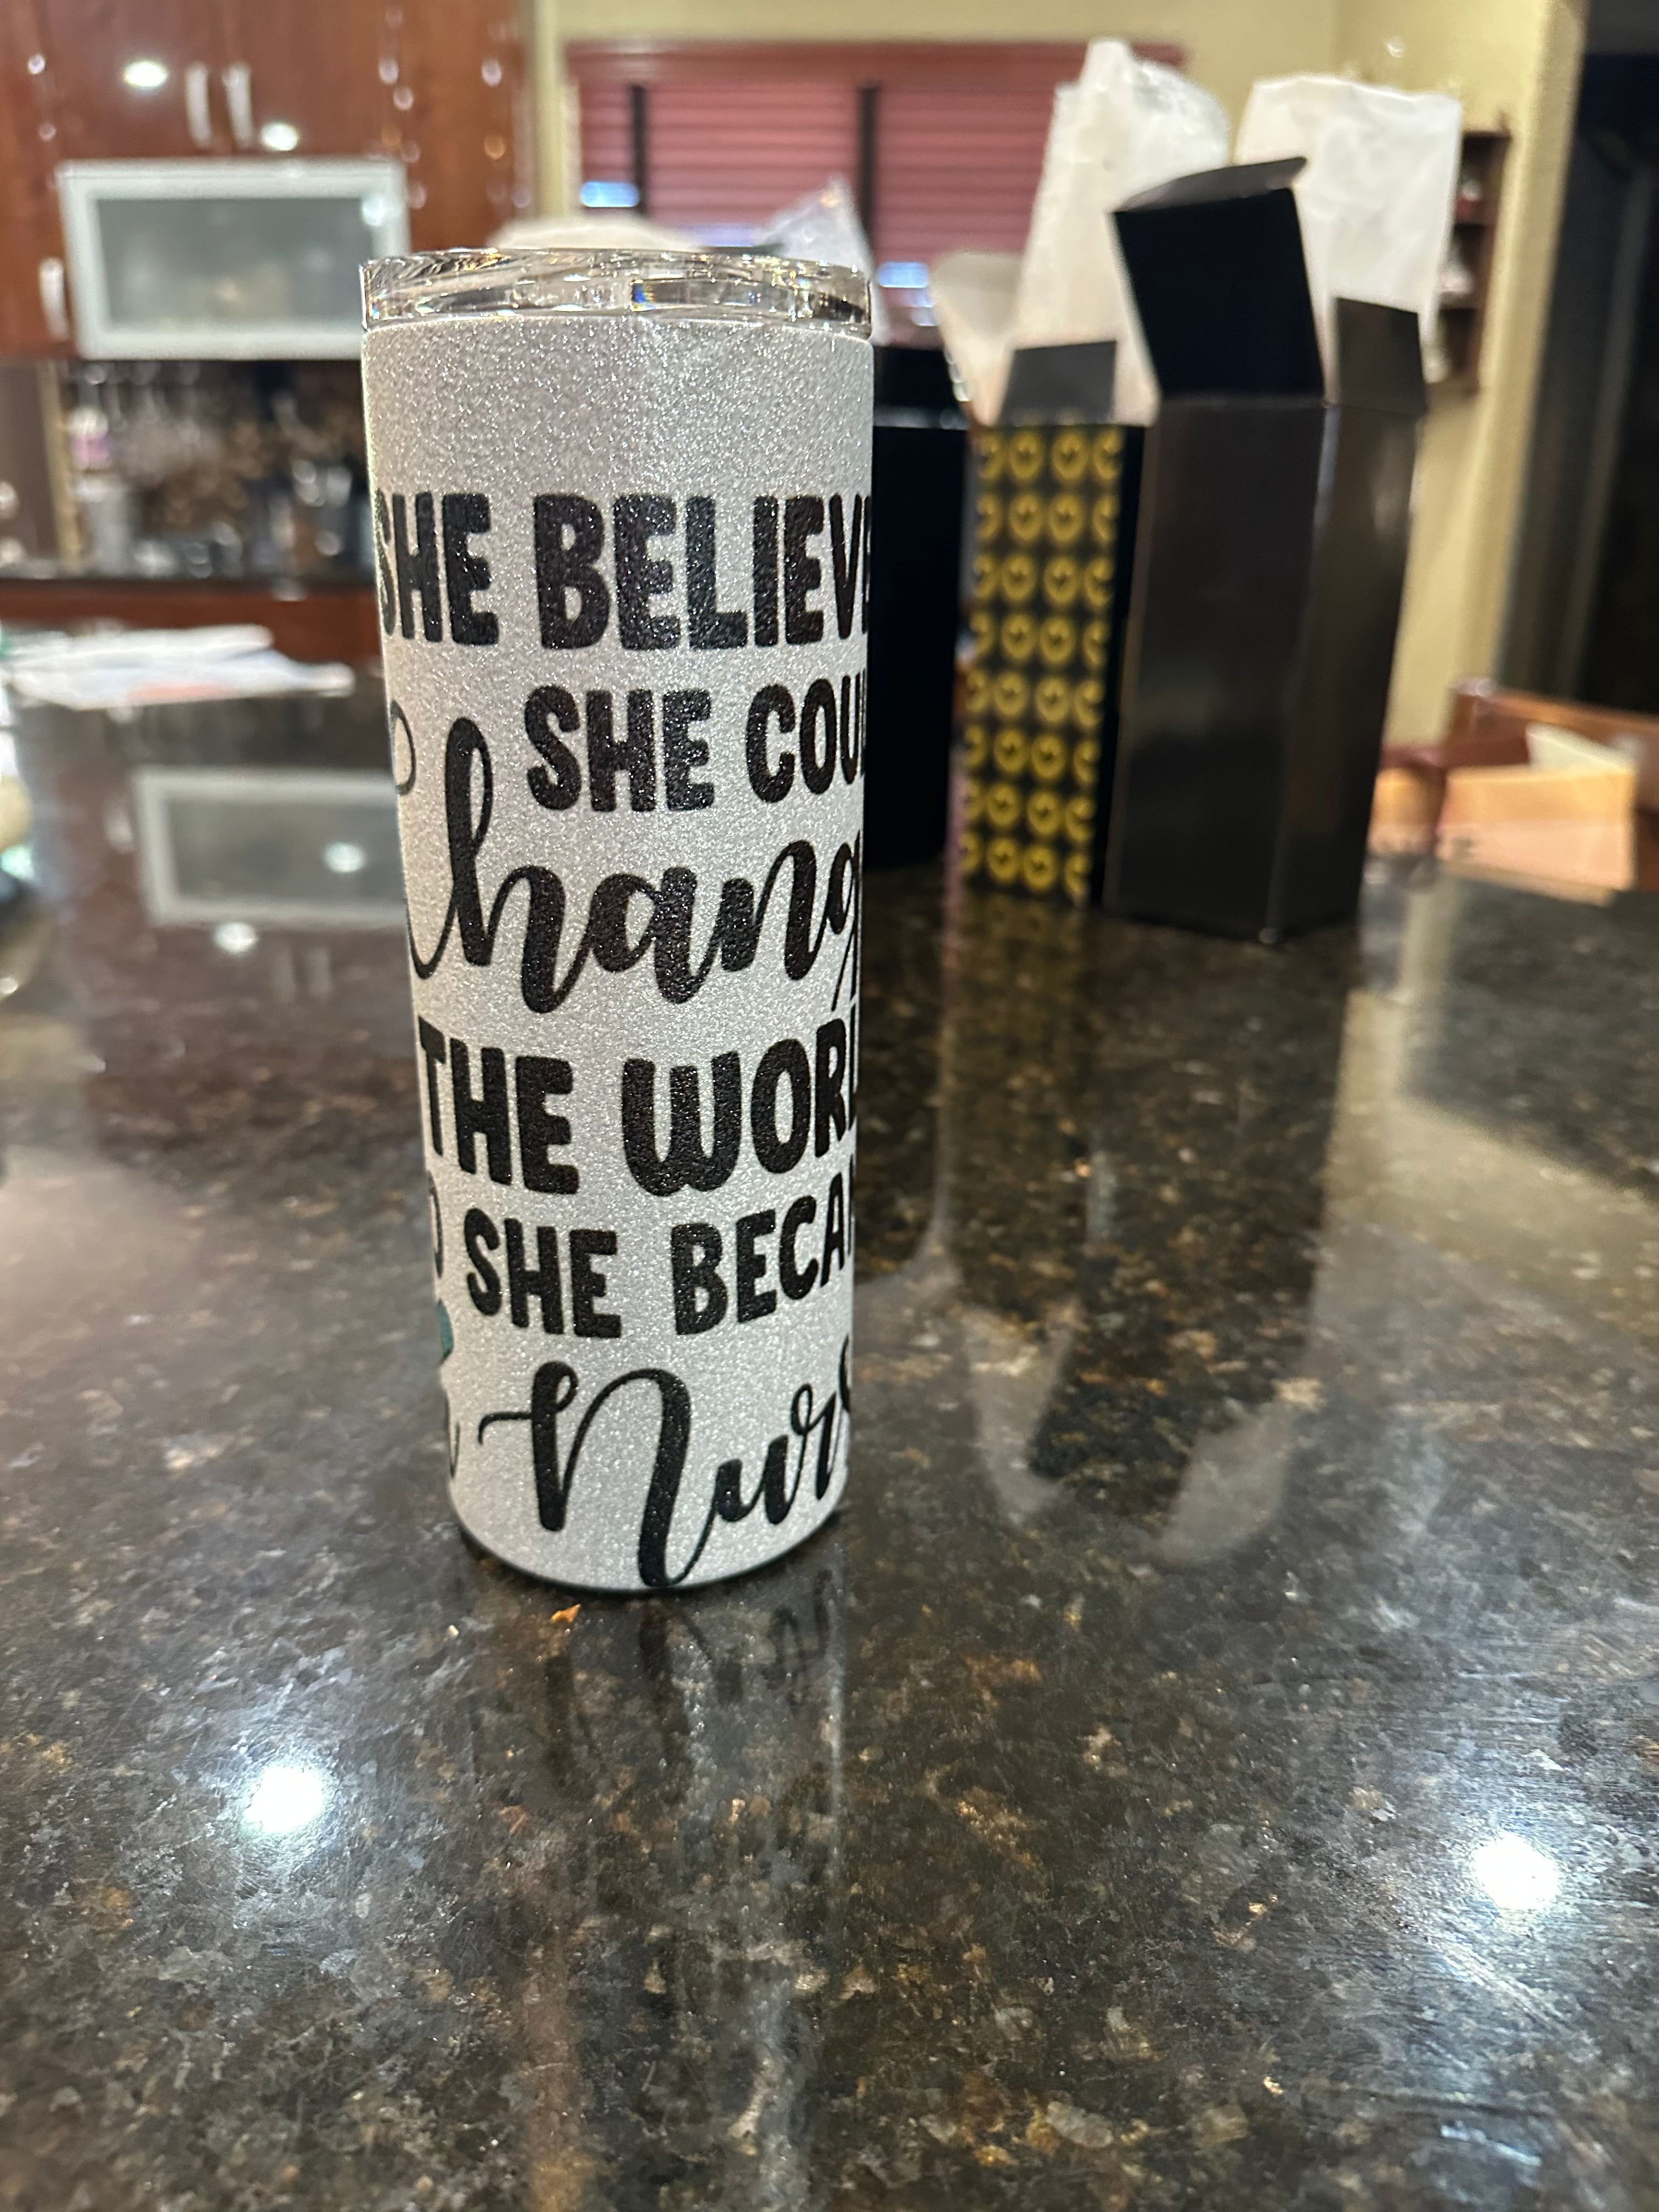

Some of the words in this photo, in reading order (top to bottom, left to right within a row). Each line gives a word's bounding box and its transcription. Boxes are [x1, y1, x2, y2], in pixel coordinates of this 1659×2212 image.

[375, 487, 499, 646] SHE
[524, 685, 714, 812] SHE
[417, 1015, 580, 1195] THE
[464, 1207, 622, 1338] SHE
[671, 1153, 855, 1335] BECA
